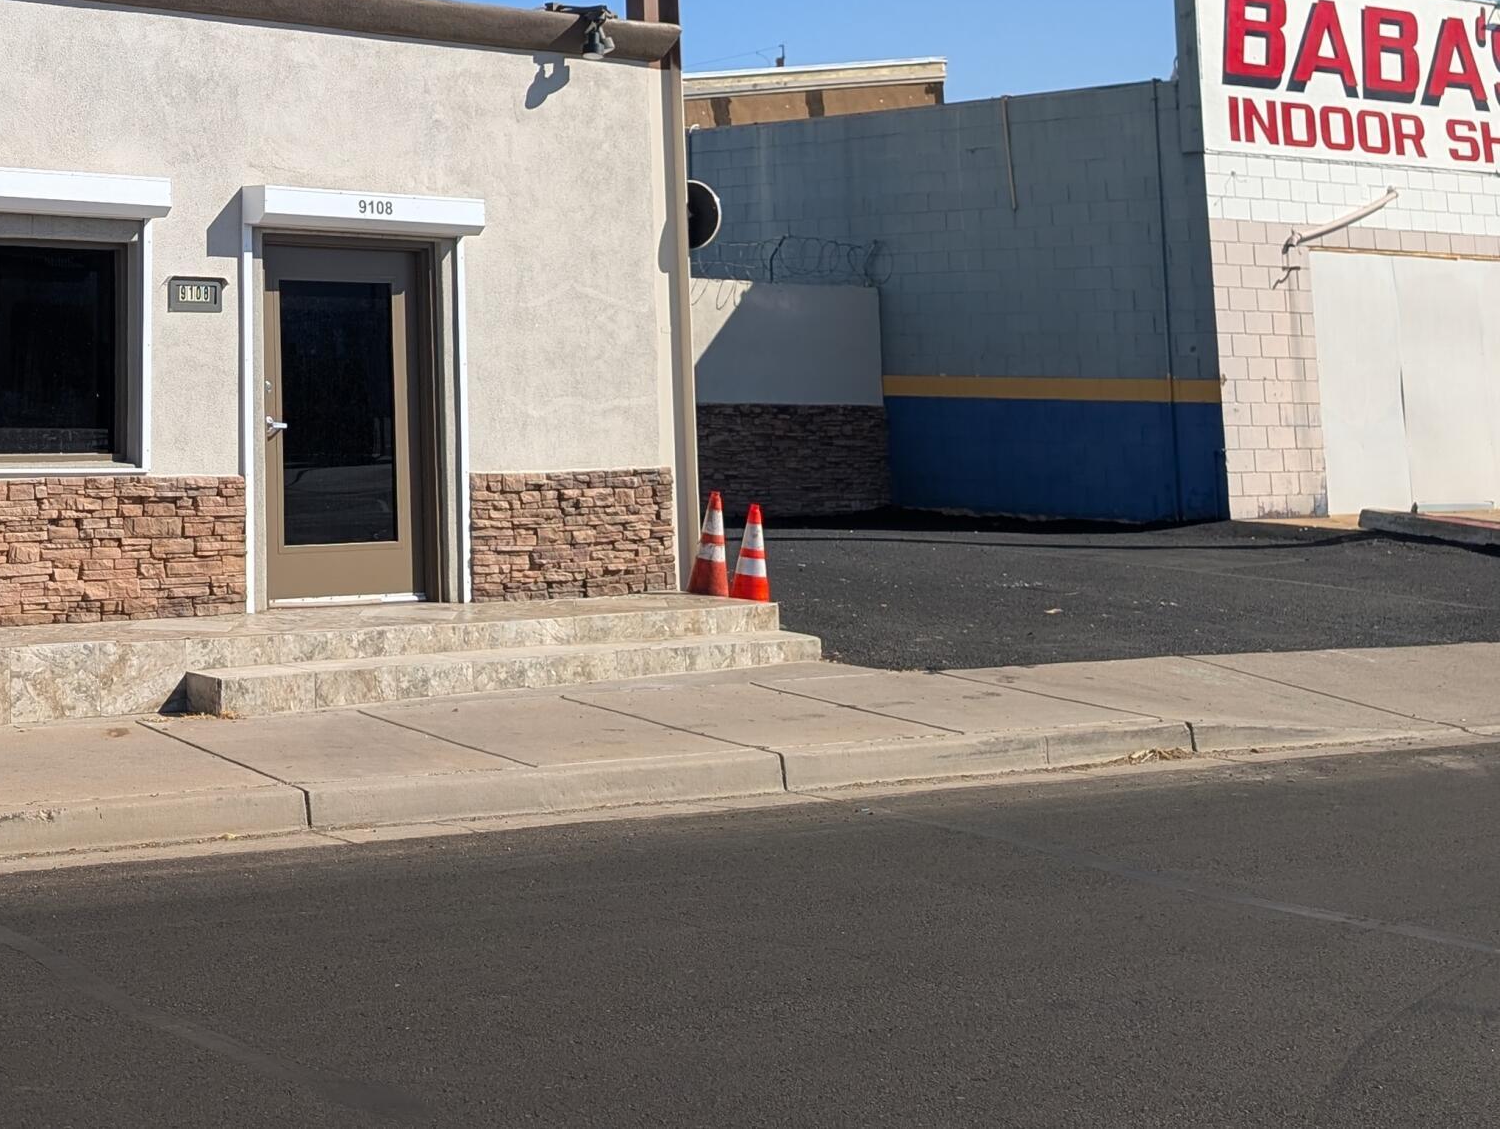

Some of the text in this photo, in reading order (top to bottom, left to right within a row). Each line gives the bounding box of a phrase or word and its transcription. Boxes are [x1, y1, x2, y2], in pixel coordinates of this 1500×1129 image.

[1229, 96, 1428, 159] INDOOR
[358, 199, 393, 215] 9108
[180, 285, 209, 300] 9108
